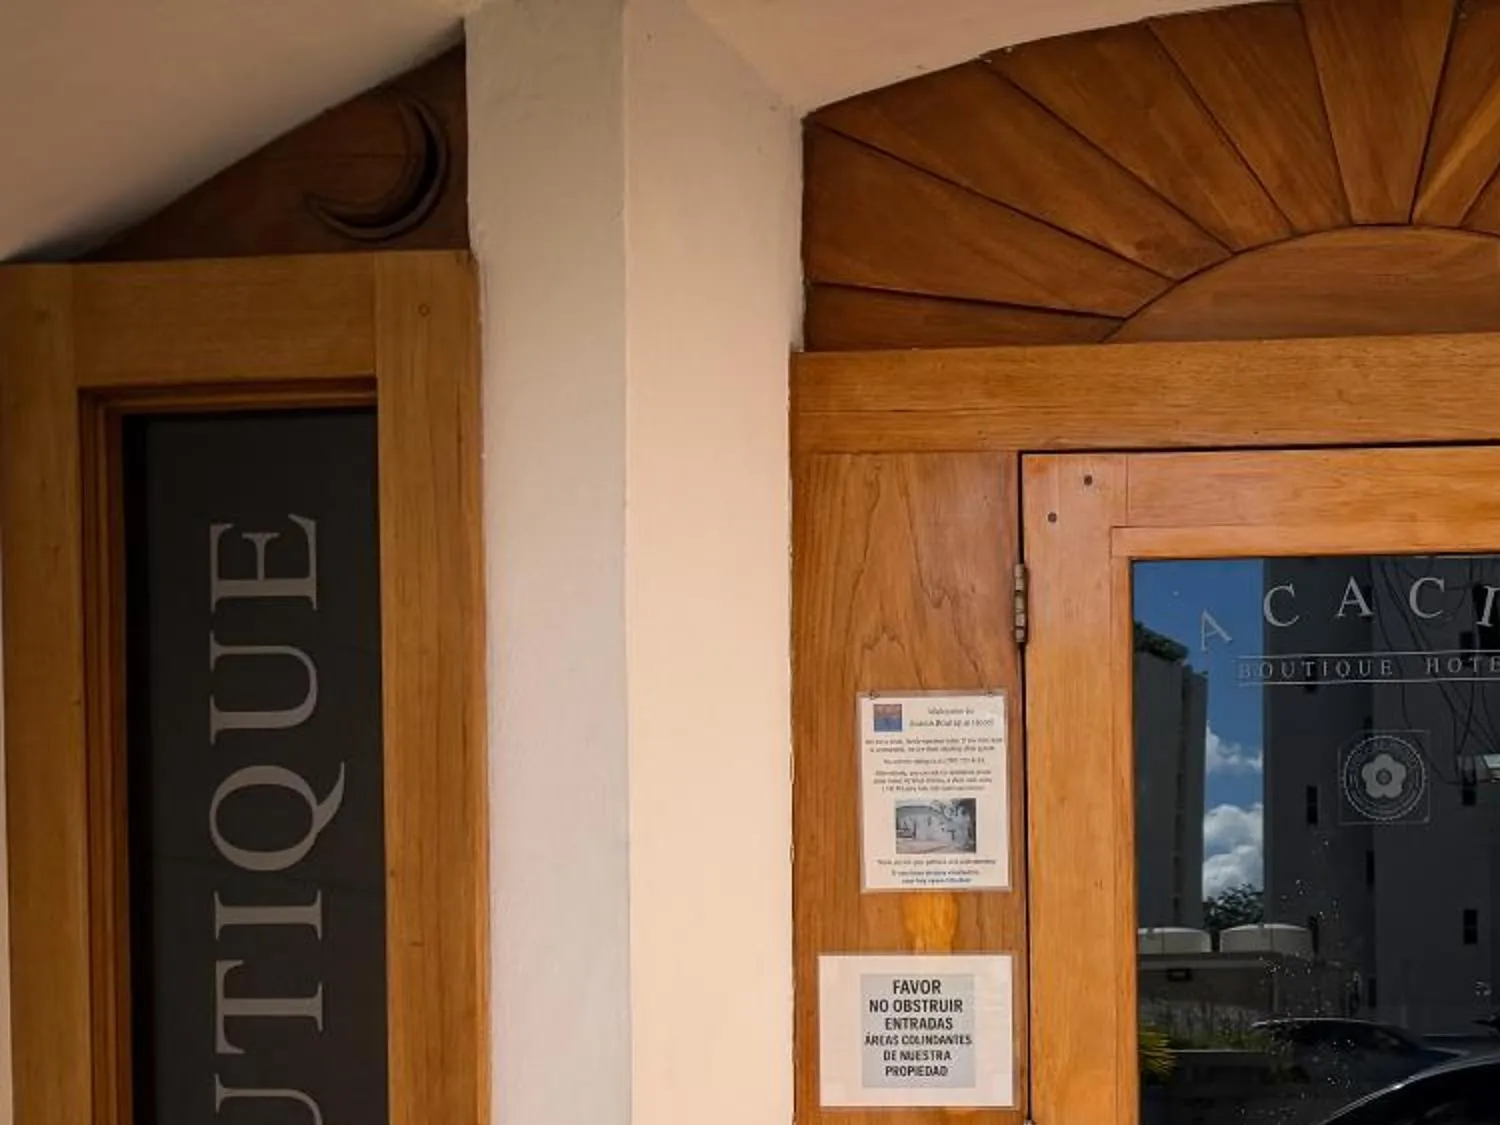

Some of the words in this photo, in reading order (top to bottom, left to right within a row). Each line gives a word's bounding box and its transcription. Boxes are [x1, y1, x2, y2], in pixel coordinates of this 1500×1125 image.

[1238, 658, 1394, 680] BOUTIQUE
[892, 979, 942, 995] FAVOR
[869, 999, 889, 1013] NO
[893, 999, 963, 1013] OBSTRUIR
[885, 1017, 953, 1031] ENTRADAS
[902, 1034, 972, 1045] COLINDANTES
[884, 1050, 896, 1061] DE
[900, 1050, 952, 1061] NUESTRA
[885, 1065, 948, 1077] PROPIEDAD
